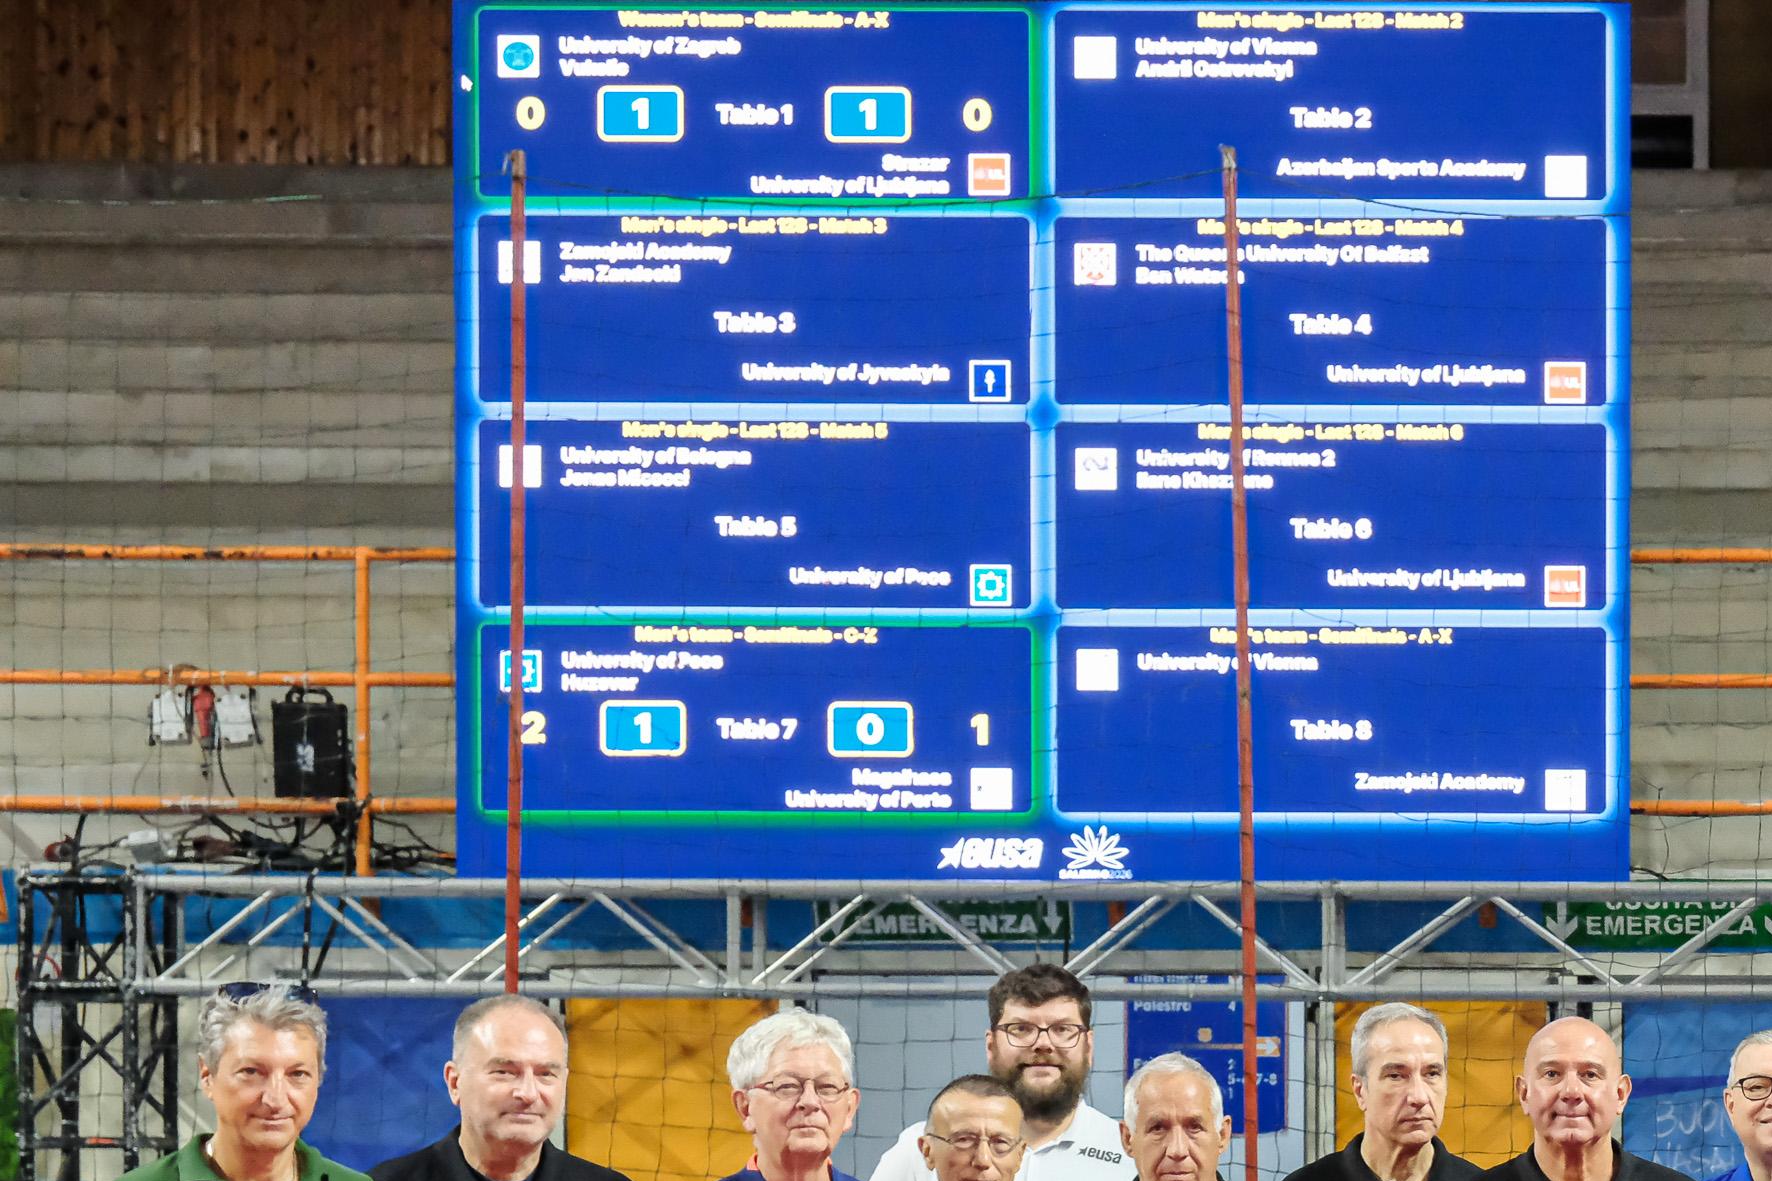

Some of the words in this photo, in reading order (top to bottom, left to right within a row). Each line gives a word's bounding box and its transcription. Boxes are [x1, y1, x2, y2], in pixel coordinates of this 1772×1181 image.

[1198, 12, 1251, 28] Men's
[1315, 12, 1352, 28] Last
[1395, 13, 1449, 28] Match
[1449, 13, 1463, 28] 2
[559, 36, 652, 59] University
[652, 36, 674, 54] of
[674, 37, 741, 58] Zagreb
[1136, 37, 1229, 60] University
[1230, 37, 1251, 55] of
[1251, 37, 1317, 55] Vienna
[516, 96, 545, 130] 0
[632, 98, 649, 129] 1
[715, 104, 779, 125] Table
[780, 104, 793, 125] 1
[860, 99, 876, 130] 1
[963, 98, 992, 131] 0
[1290, 107, 1353, 128] Table
[1355, 108, 1371, 128] 2
[1376, 159, 1438, 180] Sports
[1439, 159, 1526, 180] Academy
[751, 175, 844, 197] University
[844, 176, 865, 193] of
[622, 217, 675, 233] Men's
[739, 217, 776, 233] Last
[819, 218, 873, 233] Match
[874, 218, 887, 233] 3
[1198, 219, 1251, 234] Me's
[1315, 220, 1352, 235] Last
[1395, 220, 1449, 235] Match
[1449, 221, 1463, 235] 4
[645, 242, 731, 265] Academy
[1135, 244, 1172, 262] The
[1173, 245, 1245, 263] Queens
[1246, 244, 1339, 266] University
[1340, 245, 1363, 262] Of
[714, 312, 777, 333] Table
[779, 312, 796, 333] 3
[1289, 314, 1352, 335] Table
[1354, 314, 1372, 335] 4
[742, 362, 836, 384] University
[837, 363, 857, 381] of
[1327, 364, 1420, 386] University
[1421, 365, 1442, 382] of
[623, 422, 676, 437] Men's
[740, 423, 777, 438] Last
[820, 423, 874, 438] Match
[875, 423, 887, 439] 5
[1198, 424, 1251, 439] Mens
[1315, 425, 1352, 440] Last
[1396, 425, 1449, 440] Match
[1450, 425, 1463, 440] 6
[560, 446, 654, 470] University
[655, 447, 675, 464] of
[1137, 448, 1229, 470] University
[1229, 449, 1251, 466] f
[1321, 449, 1335, 467] 2
[715, 516, 778, 536] Table
[781, 516, 796, 537] 5
[1290, 518, 1353, 539] Table
[1355, 518, 1372, 539] 6
[790, 567, 883, 588] University
[884, 568, 904, 584] of
[1328, 568, 1420, 590] University
[1421, 569, 1442, 586] of
[636, 626, 688, 642] Men's
[1211, 628, 1263, 643] Me's
[561, 651, 655, 672] University
[656, 651, 677, 669] of
[1138, 652, 1230, 674] University
[1253, 652, 1318, 670] Vienna
[521, 711, 546, 744] 2
[635, 713, 651, 743] 1
[716, 718, 780, 739] Table
[781, 719, 797, 739] 7
[857, 713, 884, 744] 0
[971, 714, 988, 745] 1
[1290, 720, 1353, 740] Table
[1355, 720, 1372, 740] 8
[1440, 773, 1525, 794] Academy
[786, 790, 879, 811] University
[879, 790, 900, 808] of
[855, 913, 1039, 935] EMERENZA
[1087, 1147, 1122, 1164] eusa
